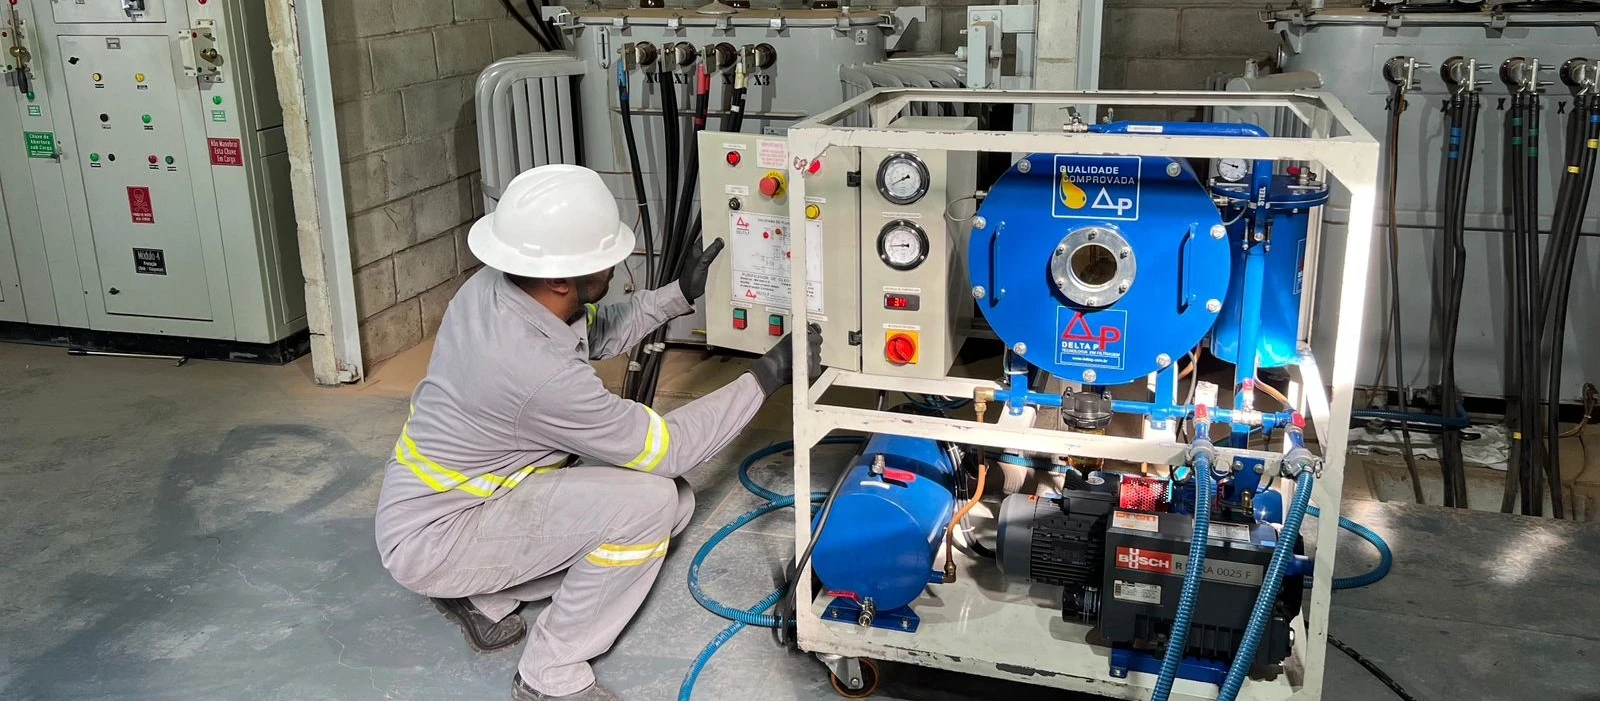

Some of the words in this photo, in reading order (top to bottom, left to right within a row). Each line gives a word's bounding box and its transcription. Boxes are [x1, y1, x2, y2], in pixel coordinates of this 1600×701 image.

[674, 73, 689, 85] X1
[753, 74, 770, 86] X3
[214, 147, 224, 155] Esta
[224, 147, 237, 155] Chave
[224, 155, 236, 164] Carga
[1059, 165, 1119, 175] QUALIDADE
[1063, 175, 1135, 185] COMPROVADA
[1061, 341, 1091, 350] DELTA
[1093, 343, 1100, 351] P
[1118, 547, 1170, 569] BUSCH
[1175, 561, 1182, 570] R
[1216, 567, 1242, 579] 0025
[1245, 571, 1252, 579] F
